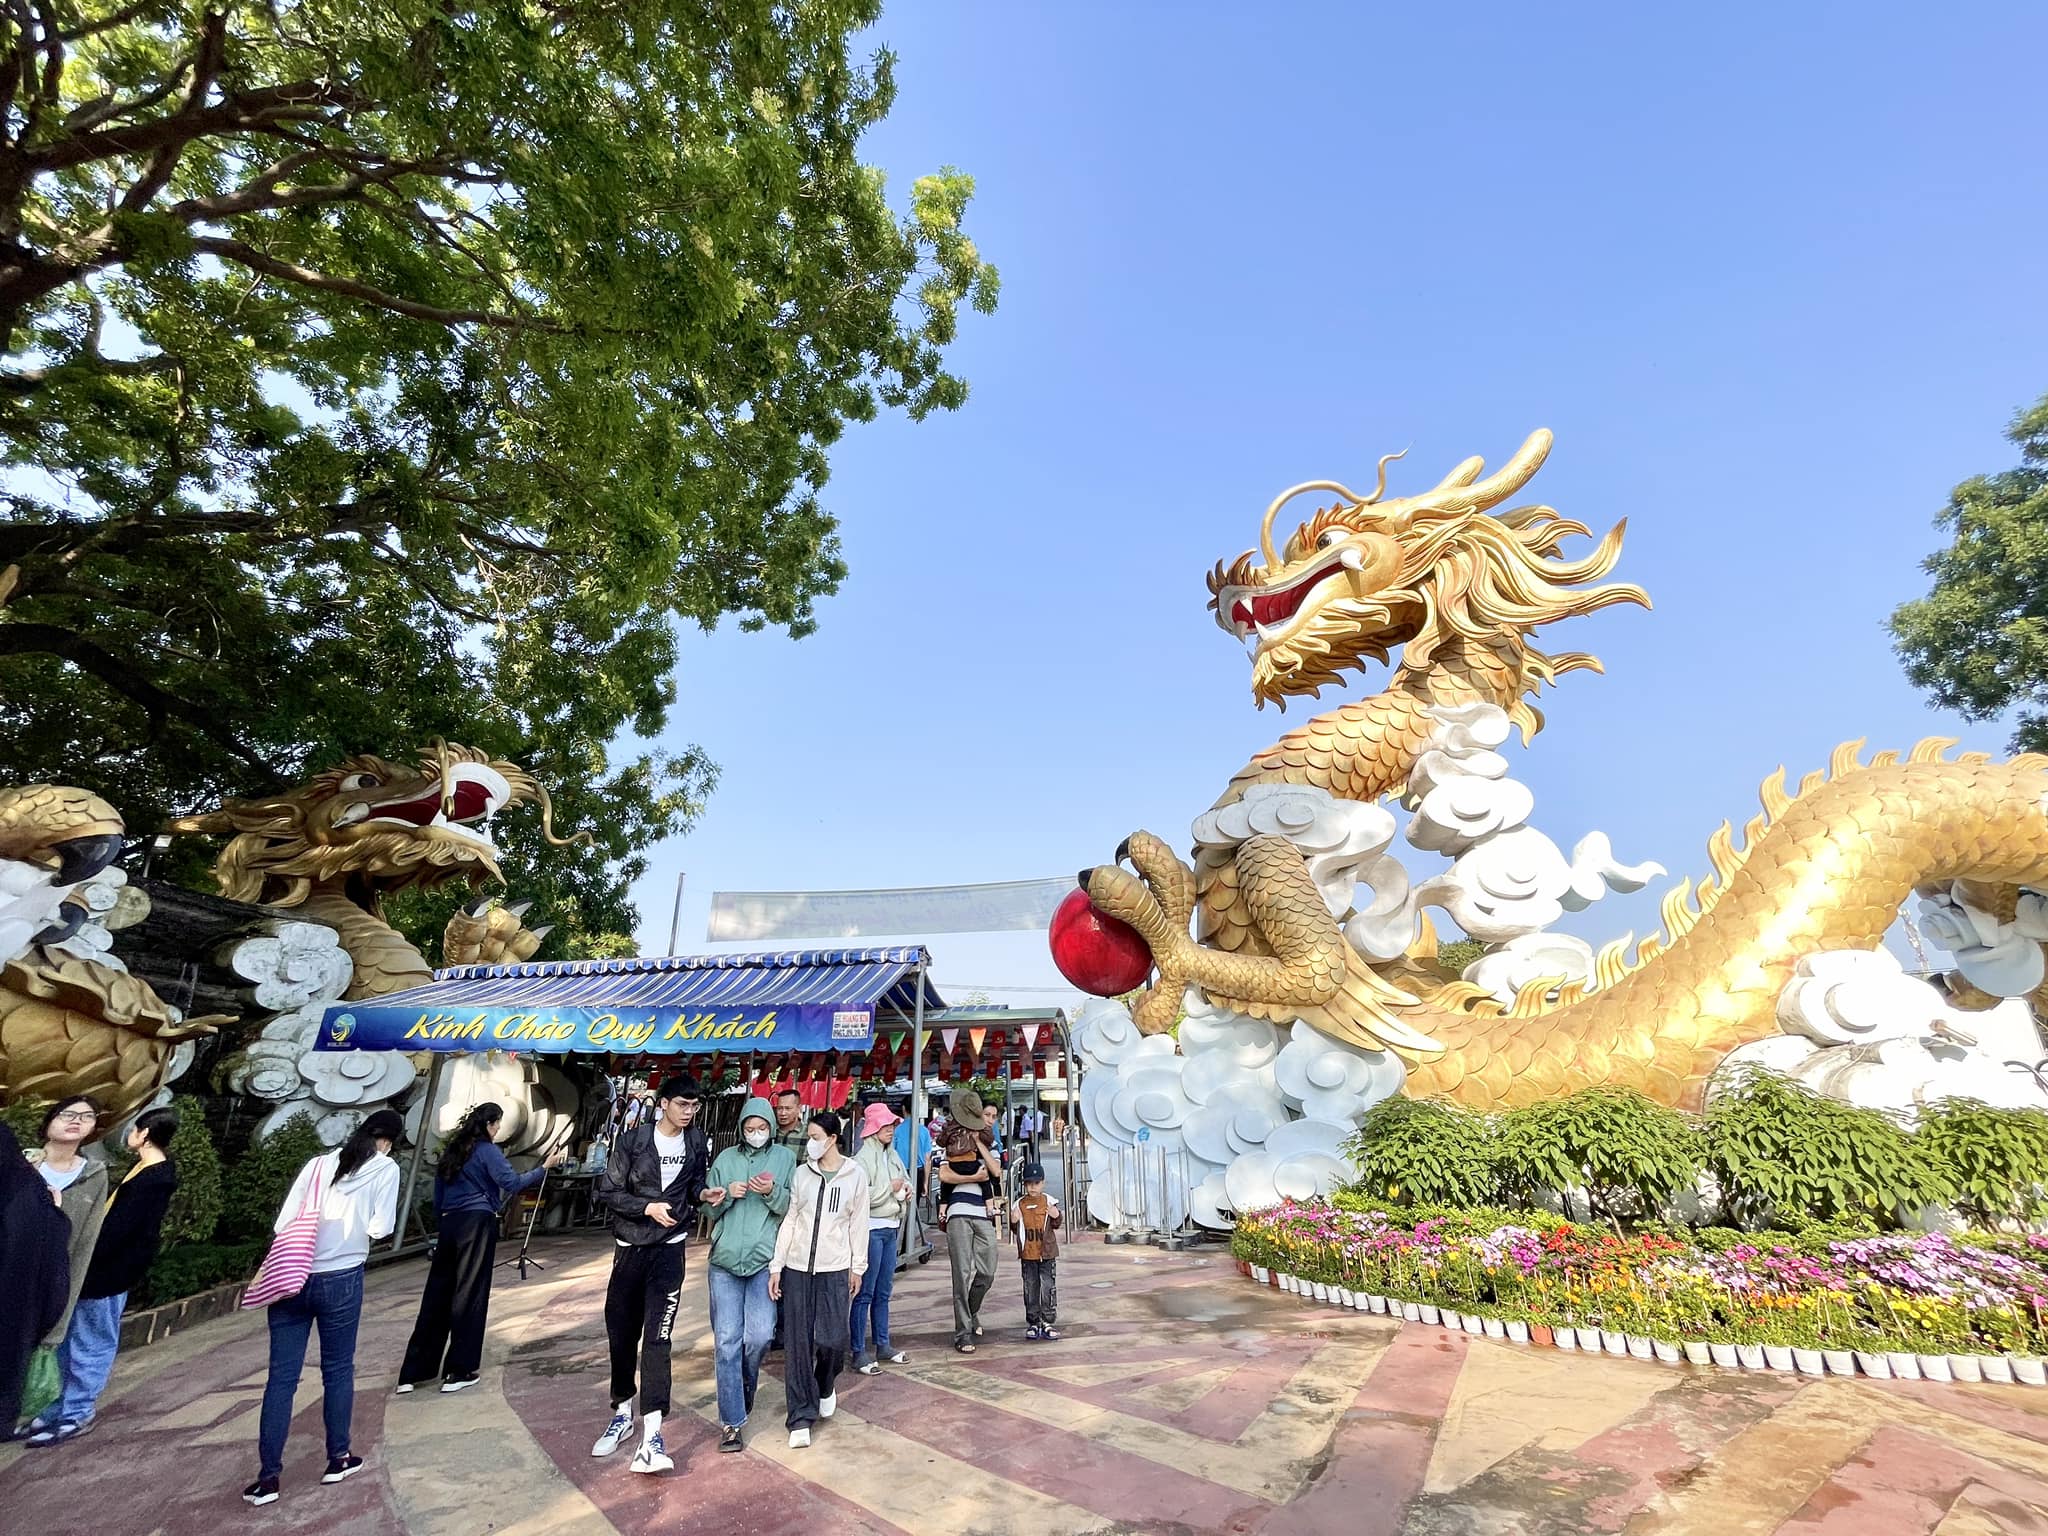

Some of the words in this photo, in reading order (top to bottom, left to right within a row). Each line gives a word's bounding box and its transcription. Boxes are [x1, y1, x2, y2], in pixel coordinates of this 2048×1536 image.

[404, 1013, 488, 1041] Kính
[493, 1014, 577, 1041] Chào
[587, 1013, 657, 1048] Quý
[664, 1010, 778, 1041] Khách
